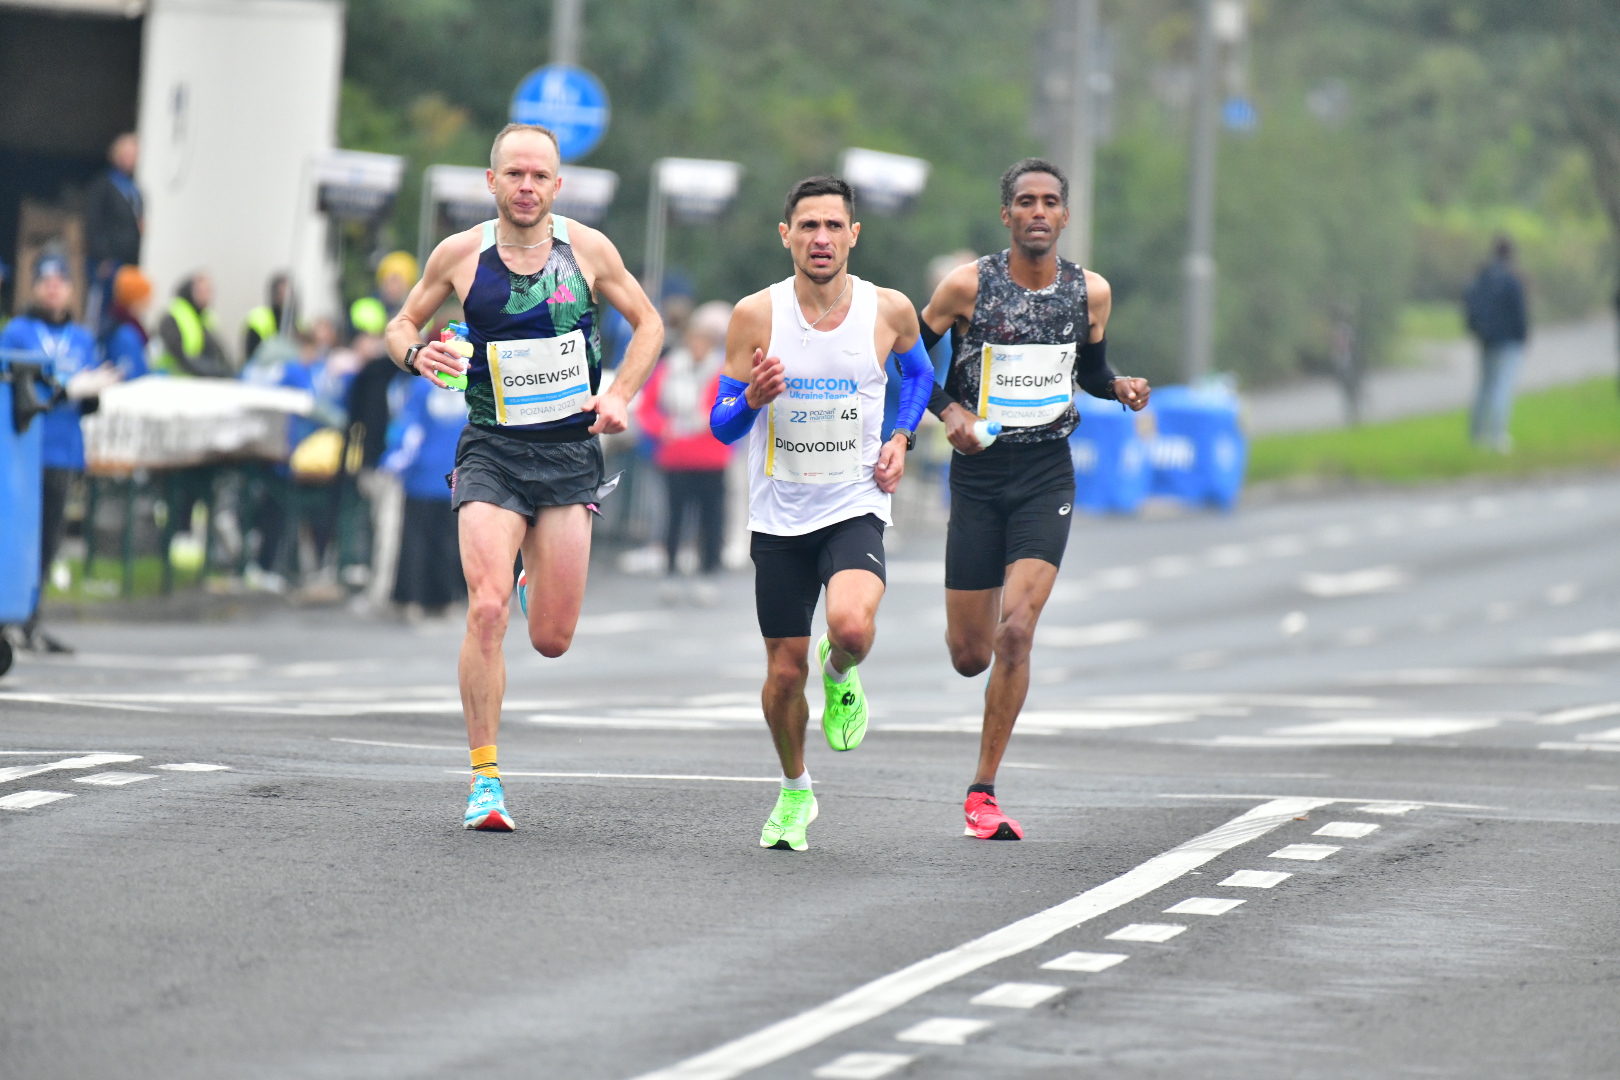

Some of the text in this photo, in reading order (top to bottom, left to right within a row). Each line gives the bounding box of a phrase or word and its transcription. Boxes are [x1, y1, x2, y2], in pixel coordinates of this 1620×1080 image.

[560, 339, 576, 355] 27
[501, 350, 513, 359] 22
[1060, 351, 1068, 363] 7
[503, 365, 580, 387] GOSIEWSKI
[996, 372, 1063, 387] SHEGUMO
[783, 377, 859, 394] saucony
[789, 391, 848, 400] Ukraine Team
[520, 399, 576, 416] POZNAŃ 2023
[841, 408, 857, 420] 45
[1001, 409, 1055, 419] POZNAŃ 2023
[790, 411, 807, 423] 22
[775, 437, 857, 453] DIDOVODIUK
